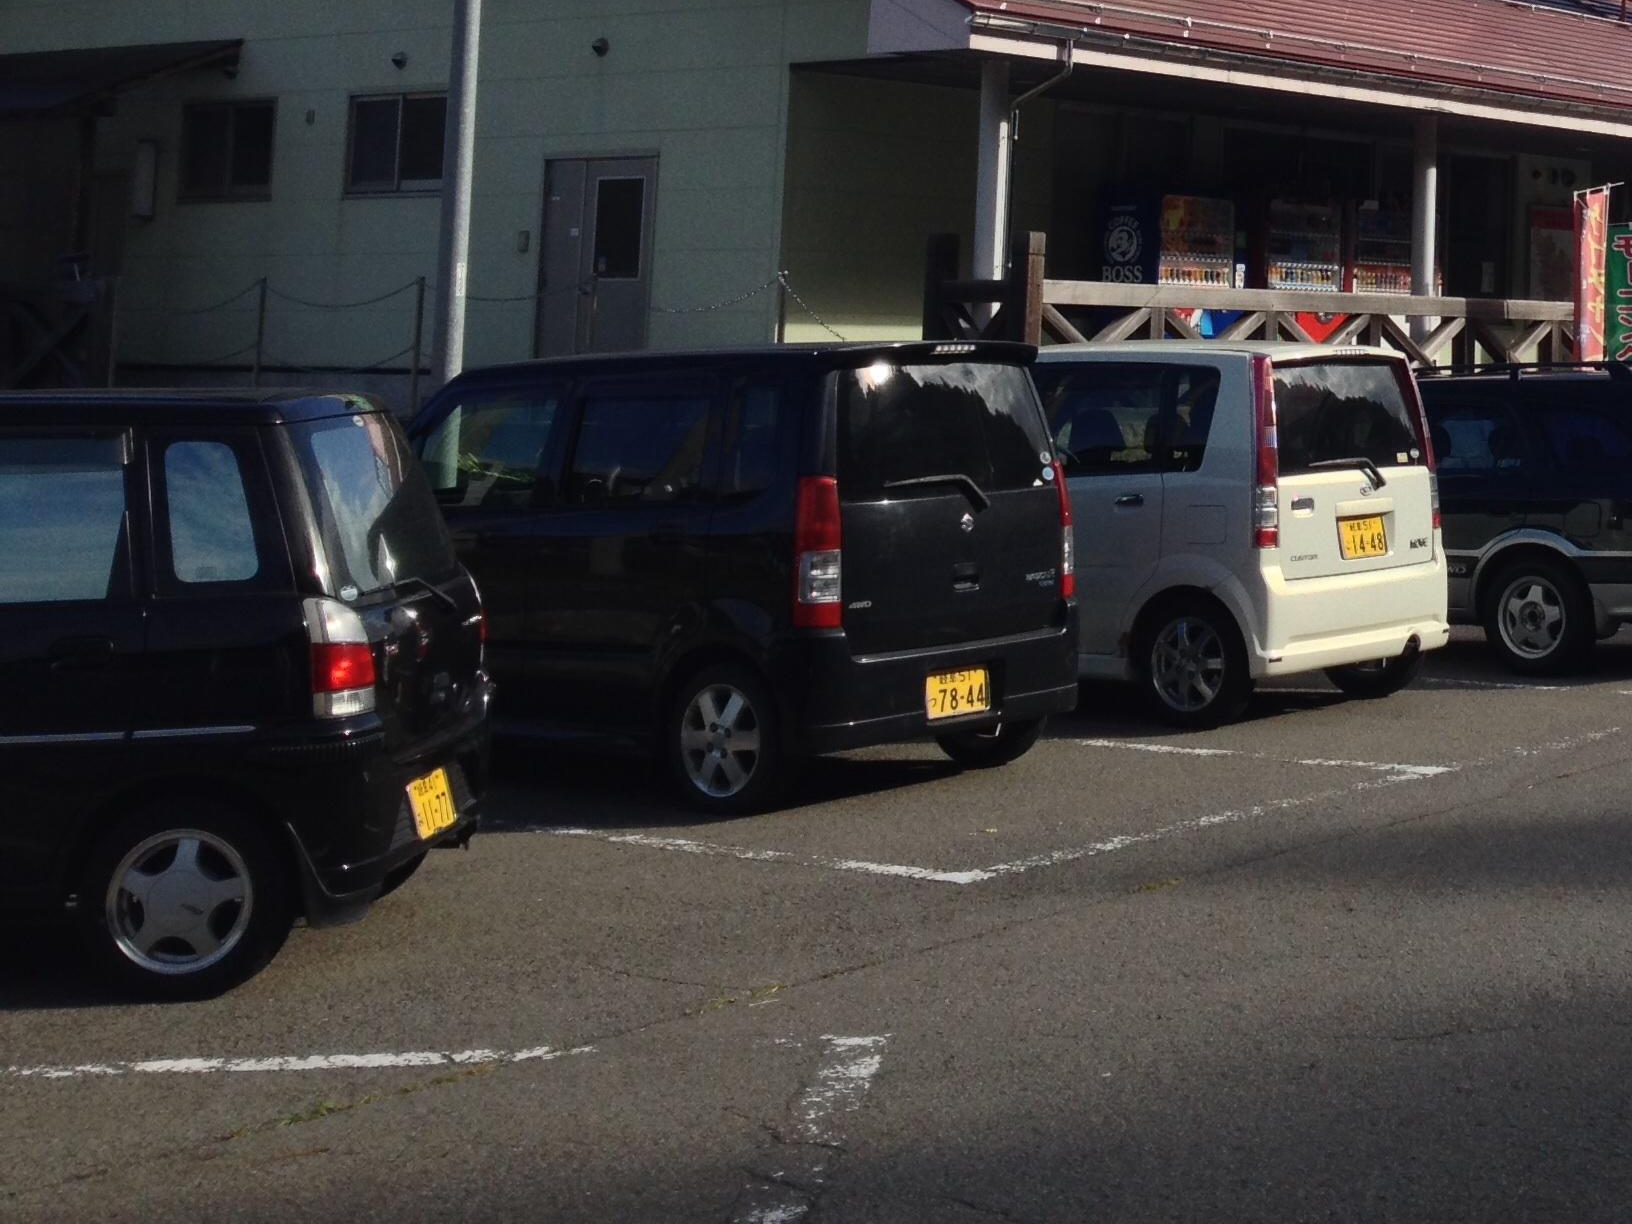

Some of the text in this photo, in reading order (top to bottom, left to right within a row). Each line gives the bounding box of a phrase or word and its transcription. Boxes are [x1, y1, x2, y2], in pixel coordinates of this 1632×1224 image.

[1101, 264, 1143, 283] BOSS
[1352, 532, 1384, 555] 14-48
[938, 682, 985, 713] 78-44
